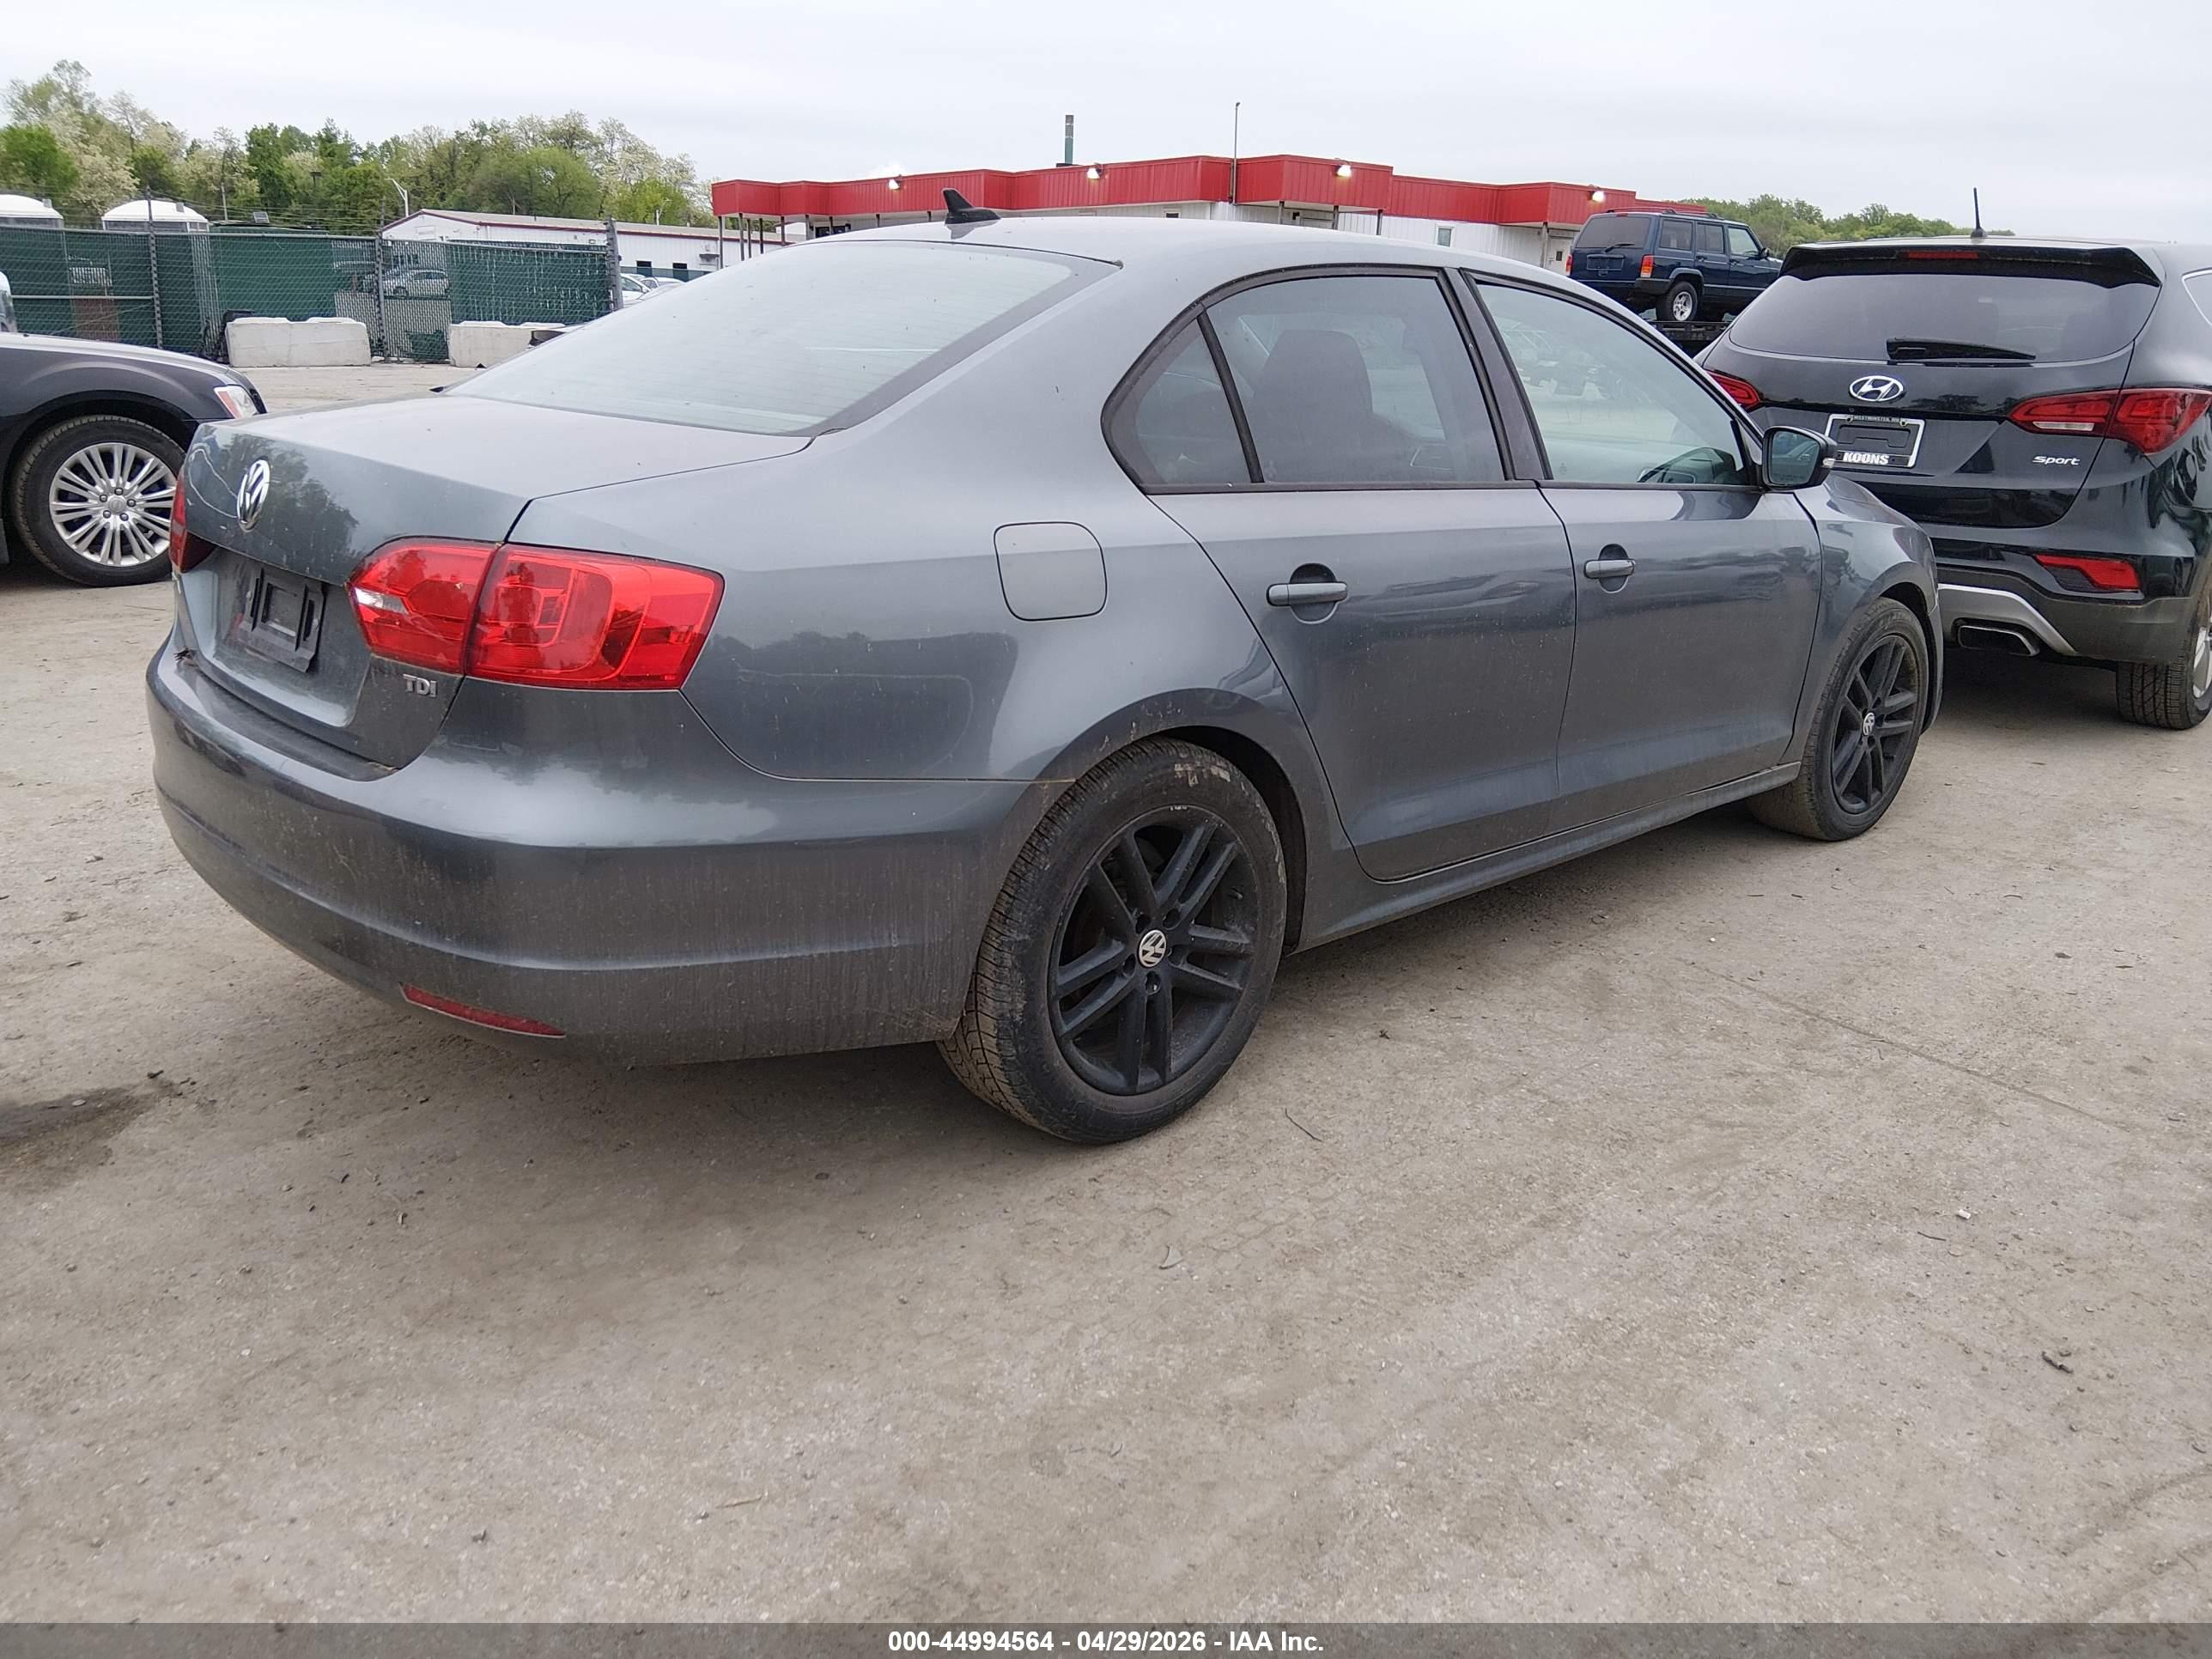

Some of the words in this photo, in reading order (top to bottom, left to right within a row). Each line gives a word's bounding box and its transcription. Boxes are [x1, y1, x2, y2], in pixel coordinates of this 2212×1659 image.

[1843, 452, 1889, 465] KOONS
[2032, 456, 2081, 465] Sport
[403, 673, 437, 697] TDI
